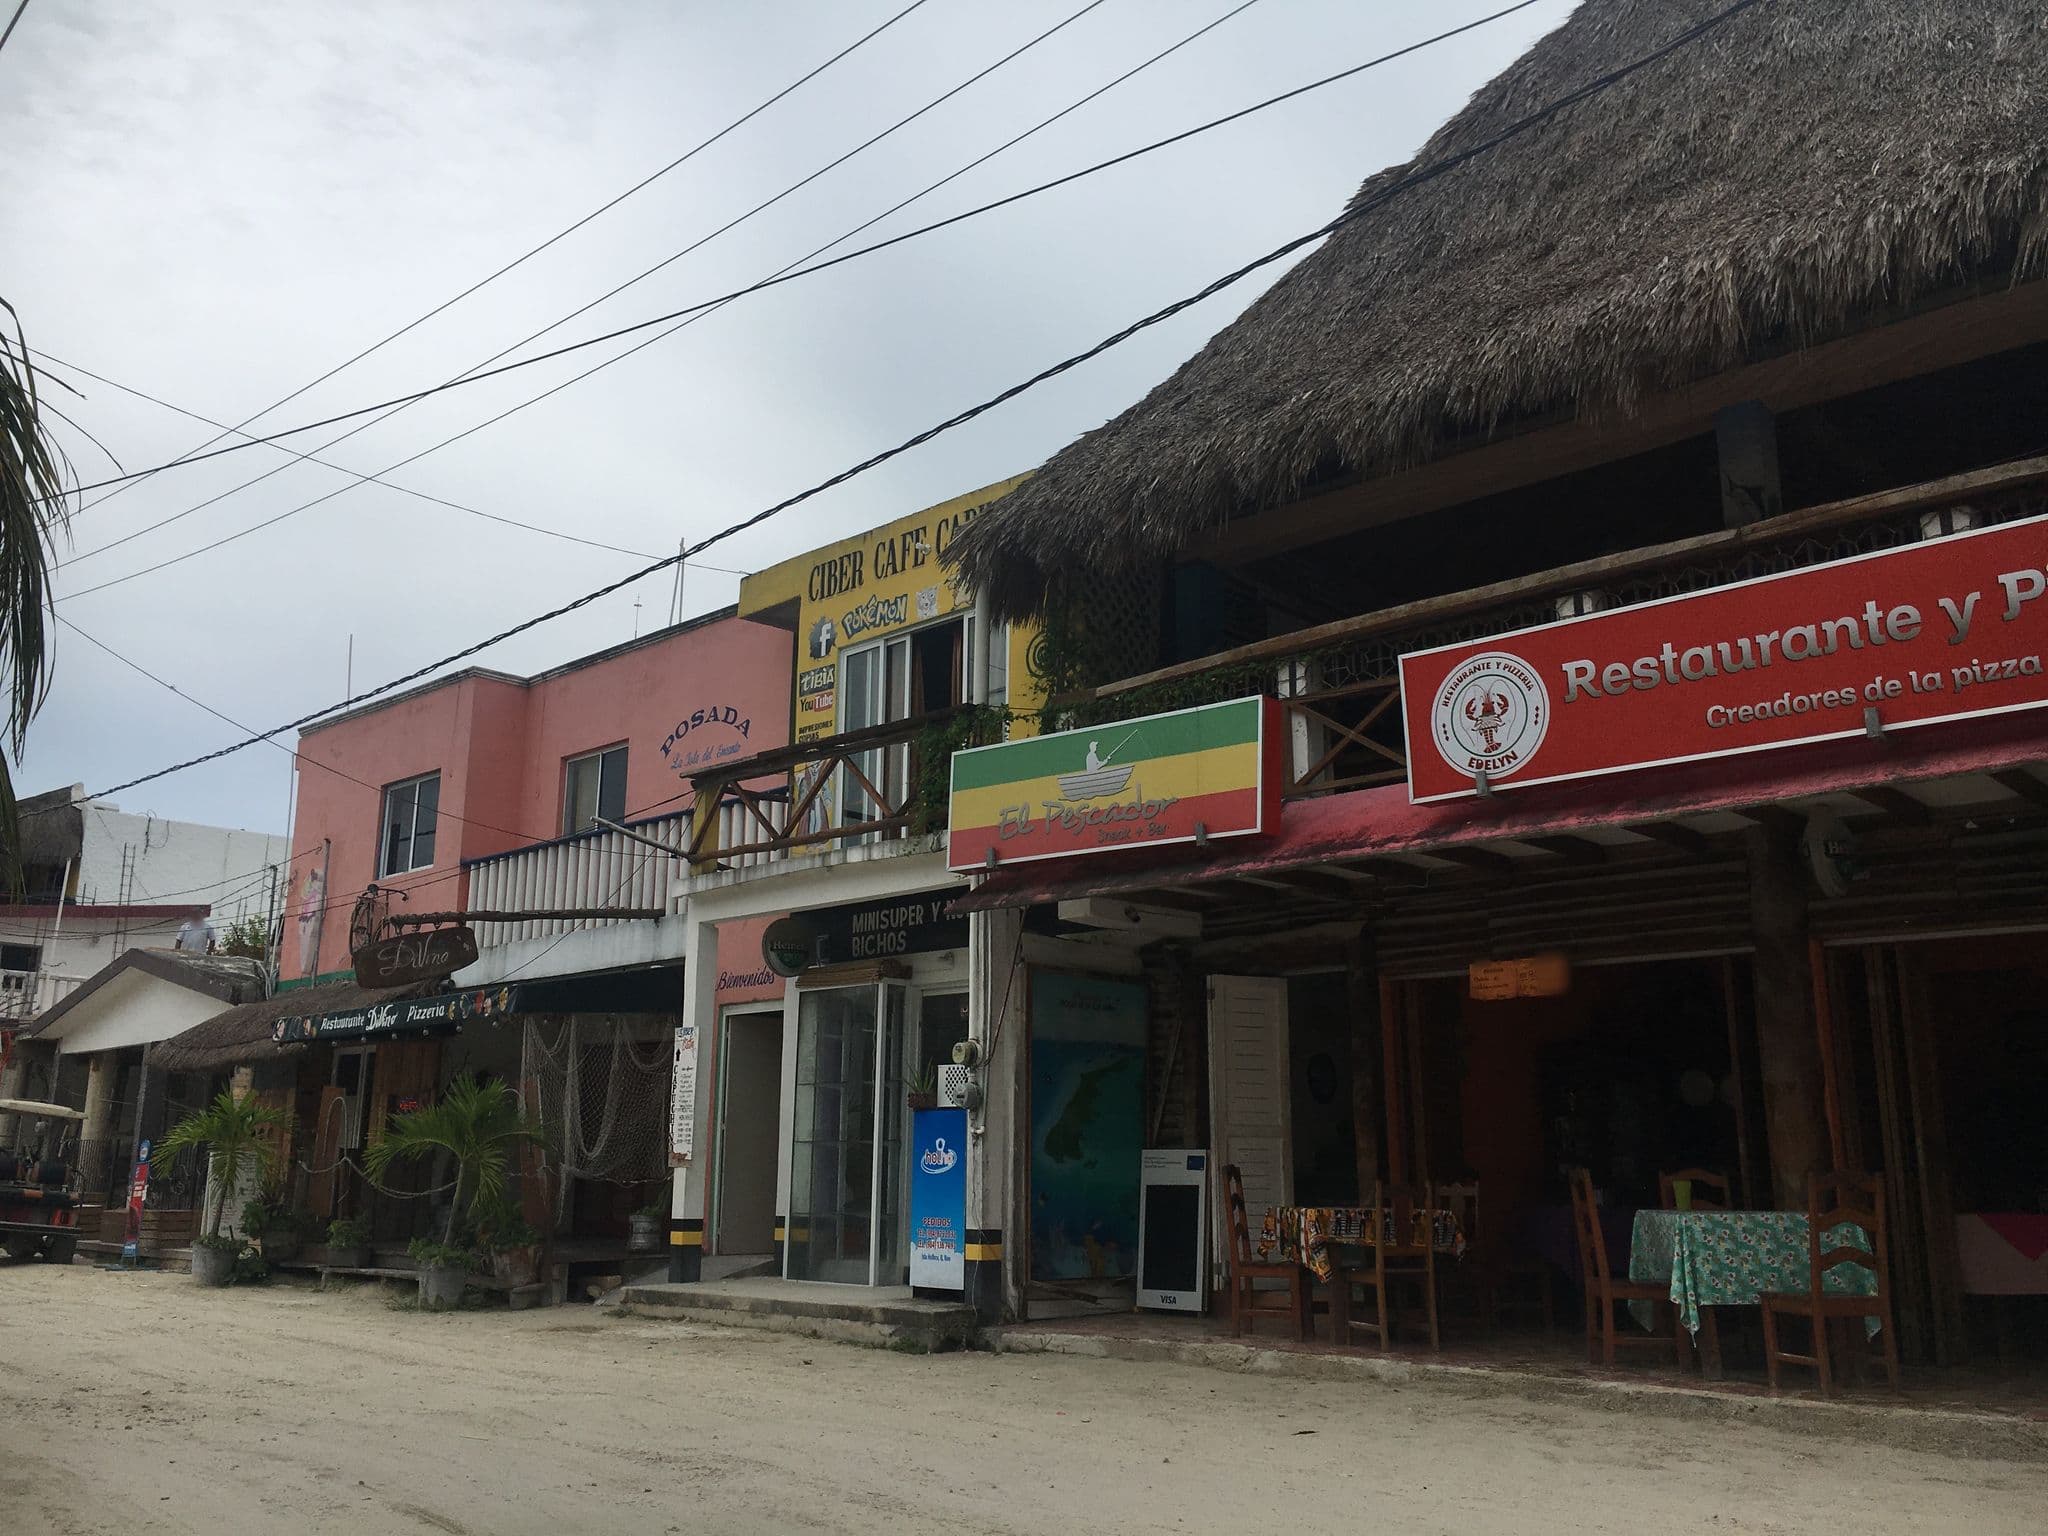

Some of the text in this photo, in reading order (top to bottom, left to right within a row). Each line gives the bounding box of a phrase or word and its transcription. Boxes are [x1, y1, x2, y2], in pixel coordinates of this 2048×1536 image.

[808, 550, 865, 602] CIBER
[874, 526, 927, 580] CAFE
[1562, 563, 2048, 704] Restaurante y P
[1441, 661, 1535, 708] RESTAURANTE Y PIZZERIA
[1705, 652, 2044, 729] Creadores de la pizza
[800, 694, 834, 713] YouTube
[660, 705, 751, 759] POSADA
[1467, 750, 1519, 771] EDELYN
[998, 783, 1180, 841] El Pescador
[852, 904, 924, 934] MINISUPER
[931, 901, 942, 923] Y
[377, 933, 450, 977] DiVino
[852, 931, 907, 958] BICHOS
[715, 965, 776, 992] Bienvenidos
[365, 1003, 400, 1032] DiVino
[406, 1004, 447, 1023] Pizzeria
[922, 1217, 952, 1228] PEDIDOS
[1160, 1294, 1177, 1306] VISA
